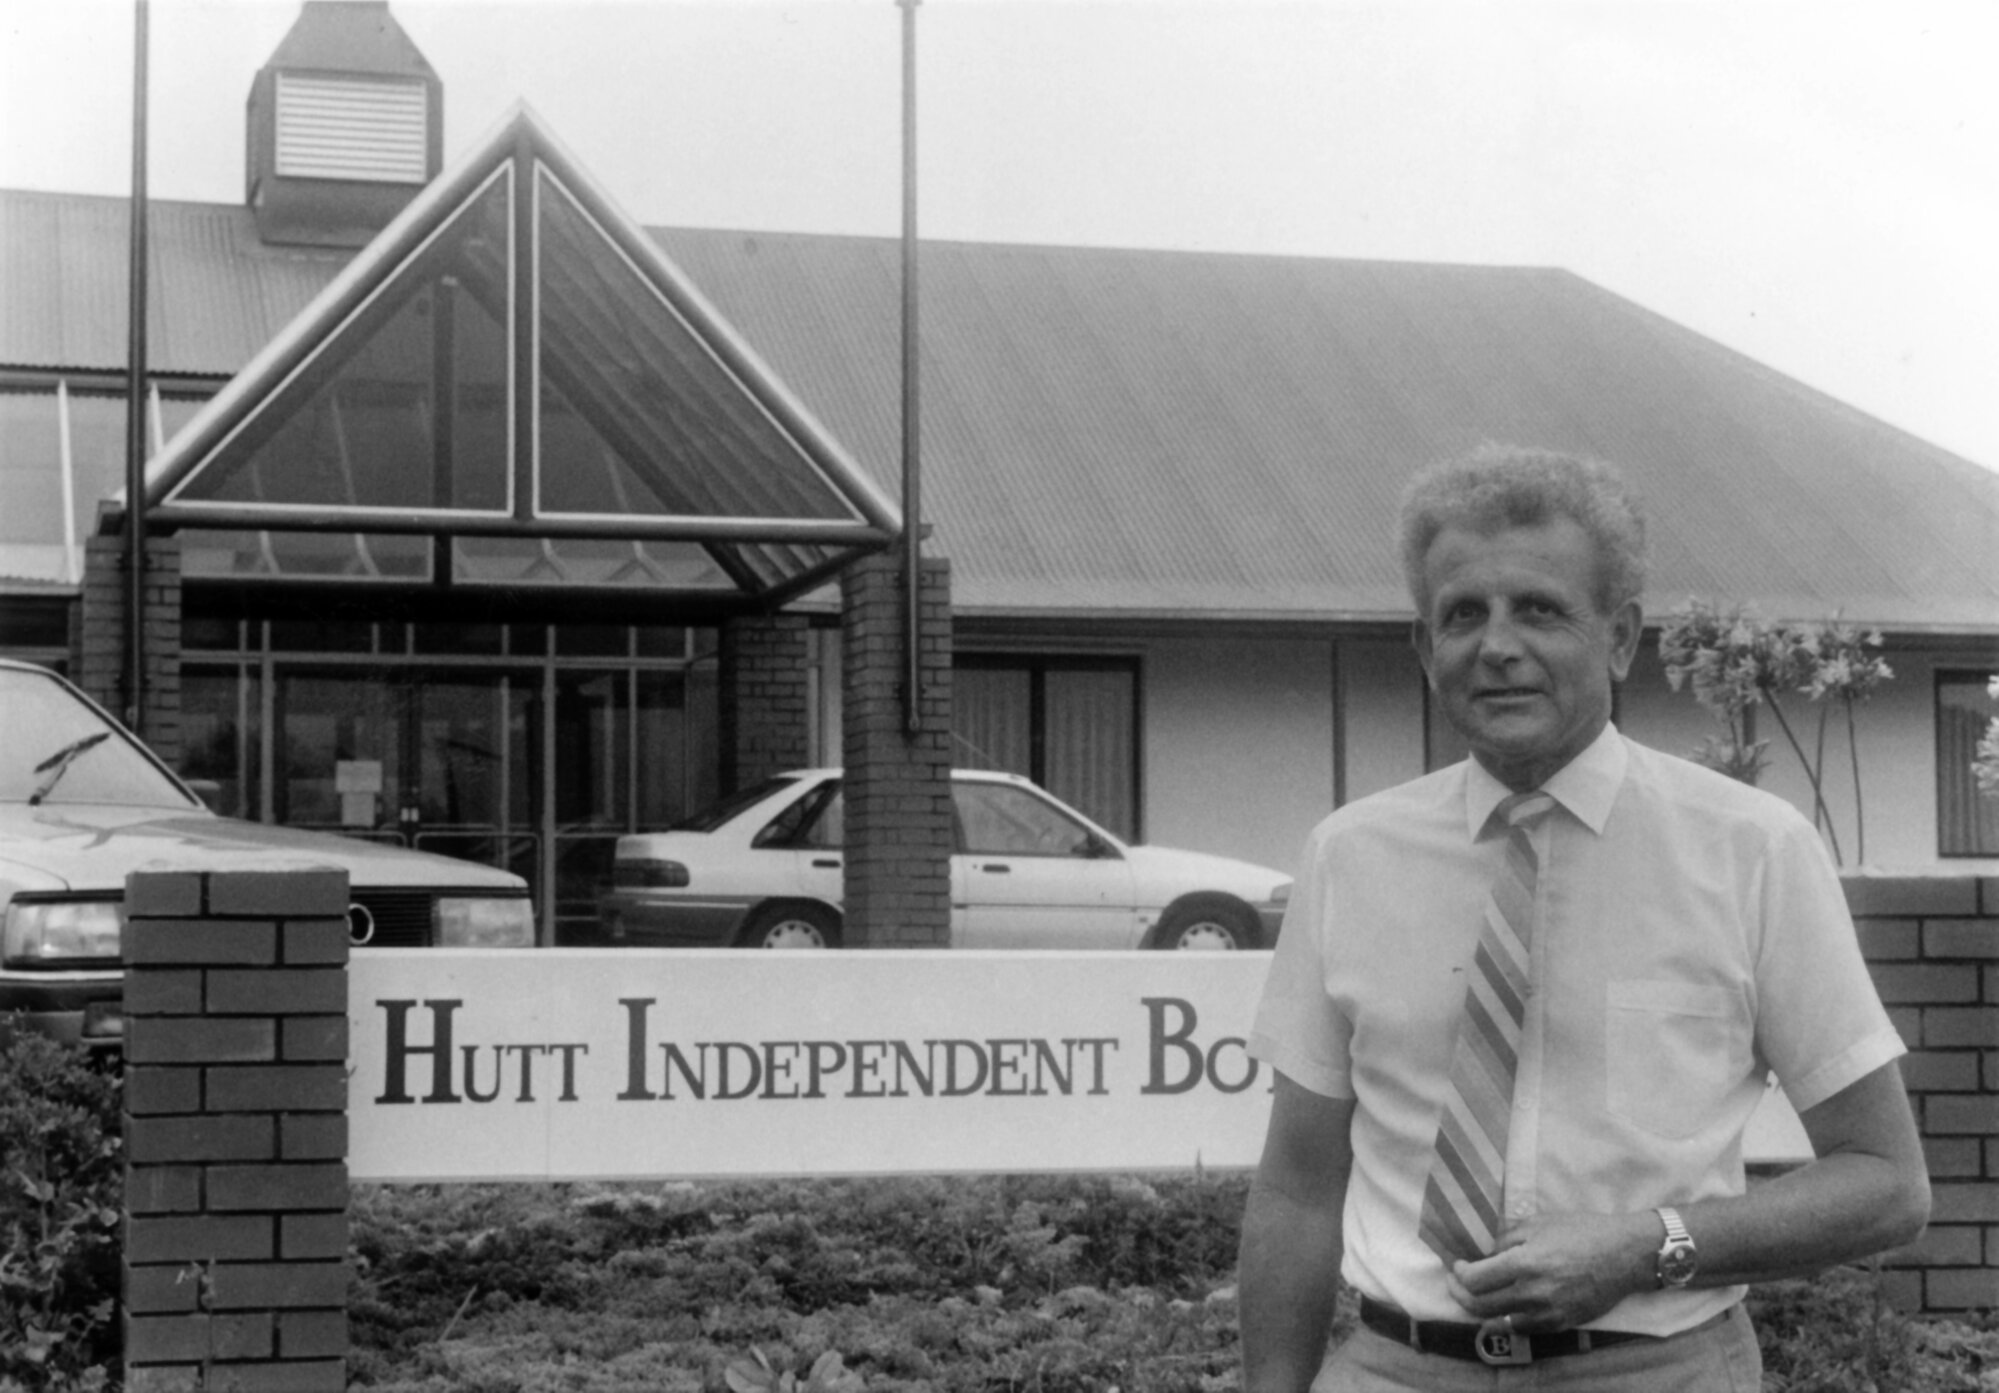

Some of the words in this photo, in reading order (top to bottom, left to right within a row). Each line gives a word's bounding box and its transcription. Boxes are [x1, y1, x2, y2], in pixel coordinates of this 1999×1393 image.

[374, 998, 588, 1105] HUTT
[616, 997, 1119, 1101] INDEPENDENT
[1141, 996, 1274, 1095] BO
